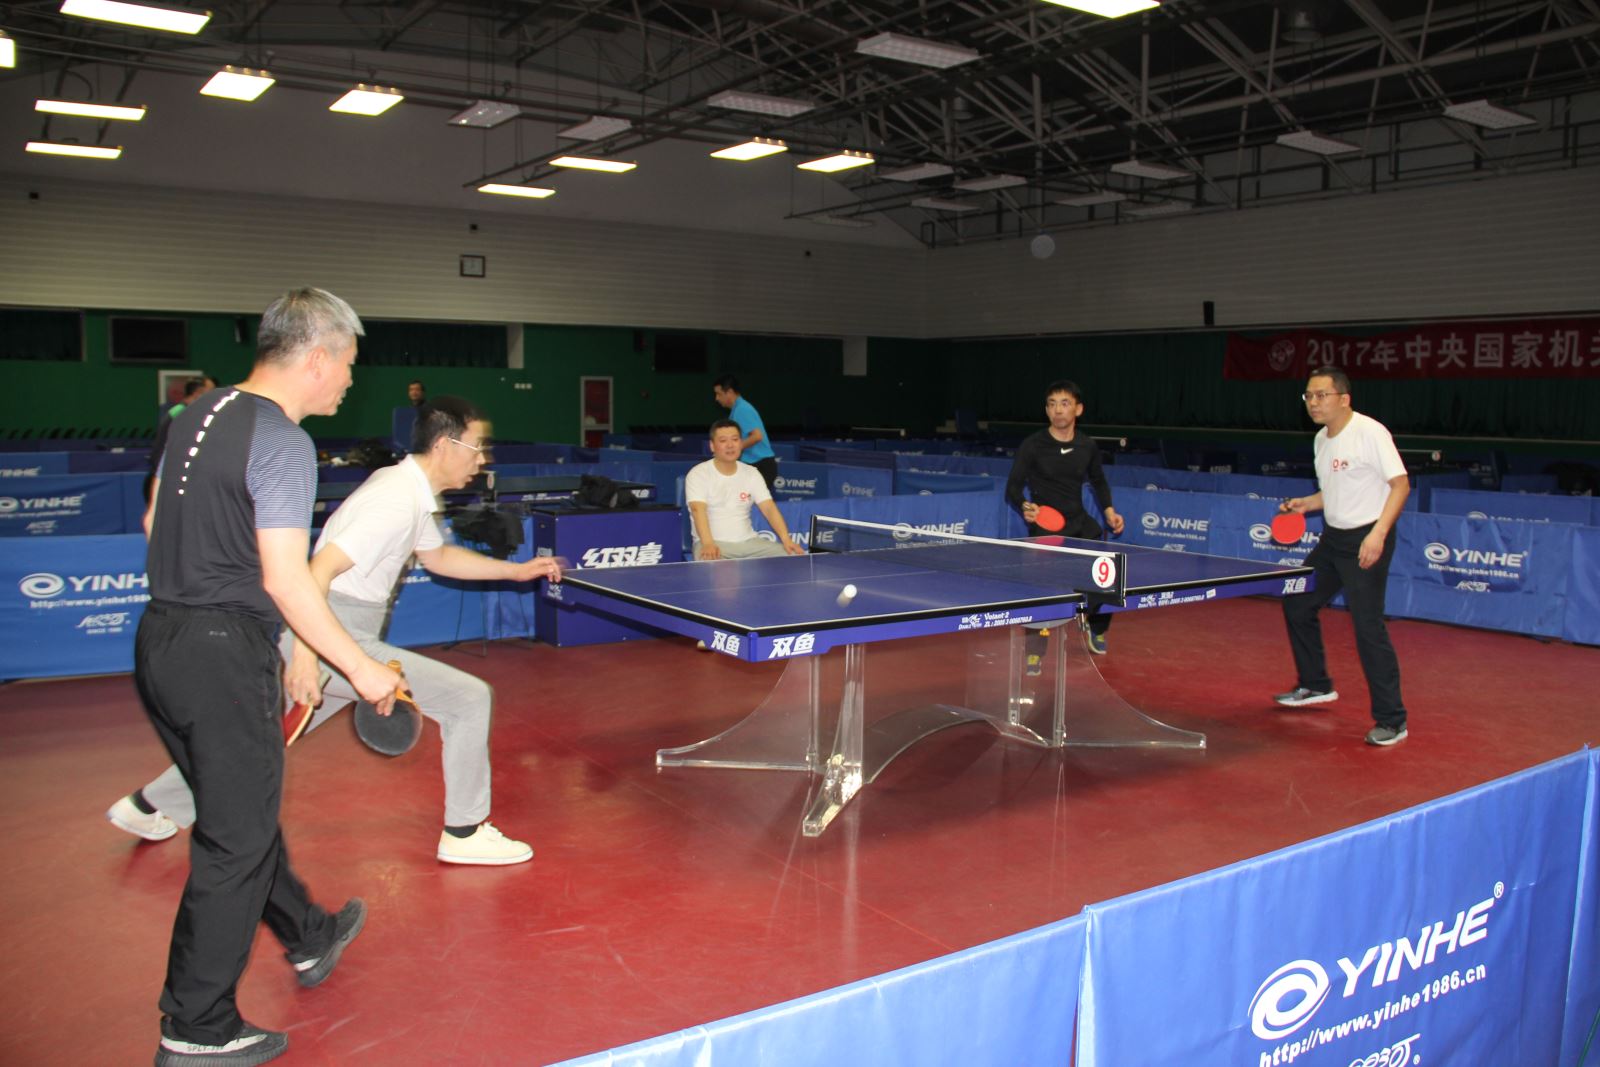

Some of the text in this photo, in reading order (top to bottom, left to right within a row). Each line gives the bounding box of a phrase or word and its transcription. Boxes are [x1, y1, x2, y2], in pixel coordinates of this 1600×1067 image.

[787, 479, 816, 488] YINHE
[21, 496, 82, 509] YINHE
[1162, 517, 1209, 531] YINHE
[1453, 548, 1523, 567] YINHE
[1098, 561, 1109, 583] 9
[68, 573, 150, 592] YINH
[711, 630, 740, 656] 双鱼
[768, 632, 815, 659] 双鱼
[1337, 897, 1494, 998] YINHE
[1259, 963, 1487, 1067] http://www.yinhe1986.cn
